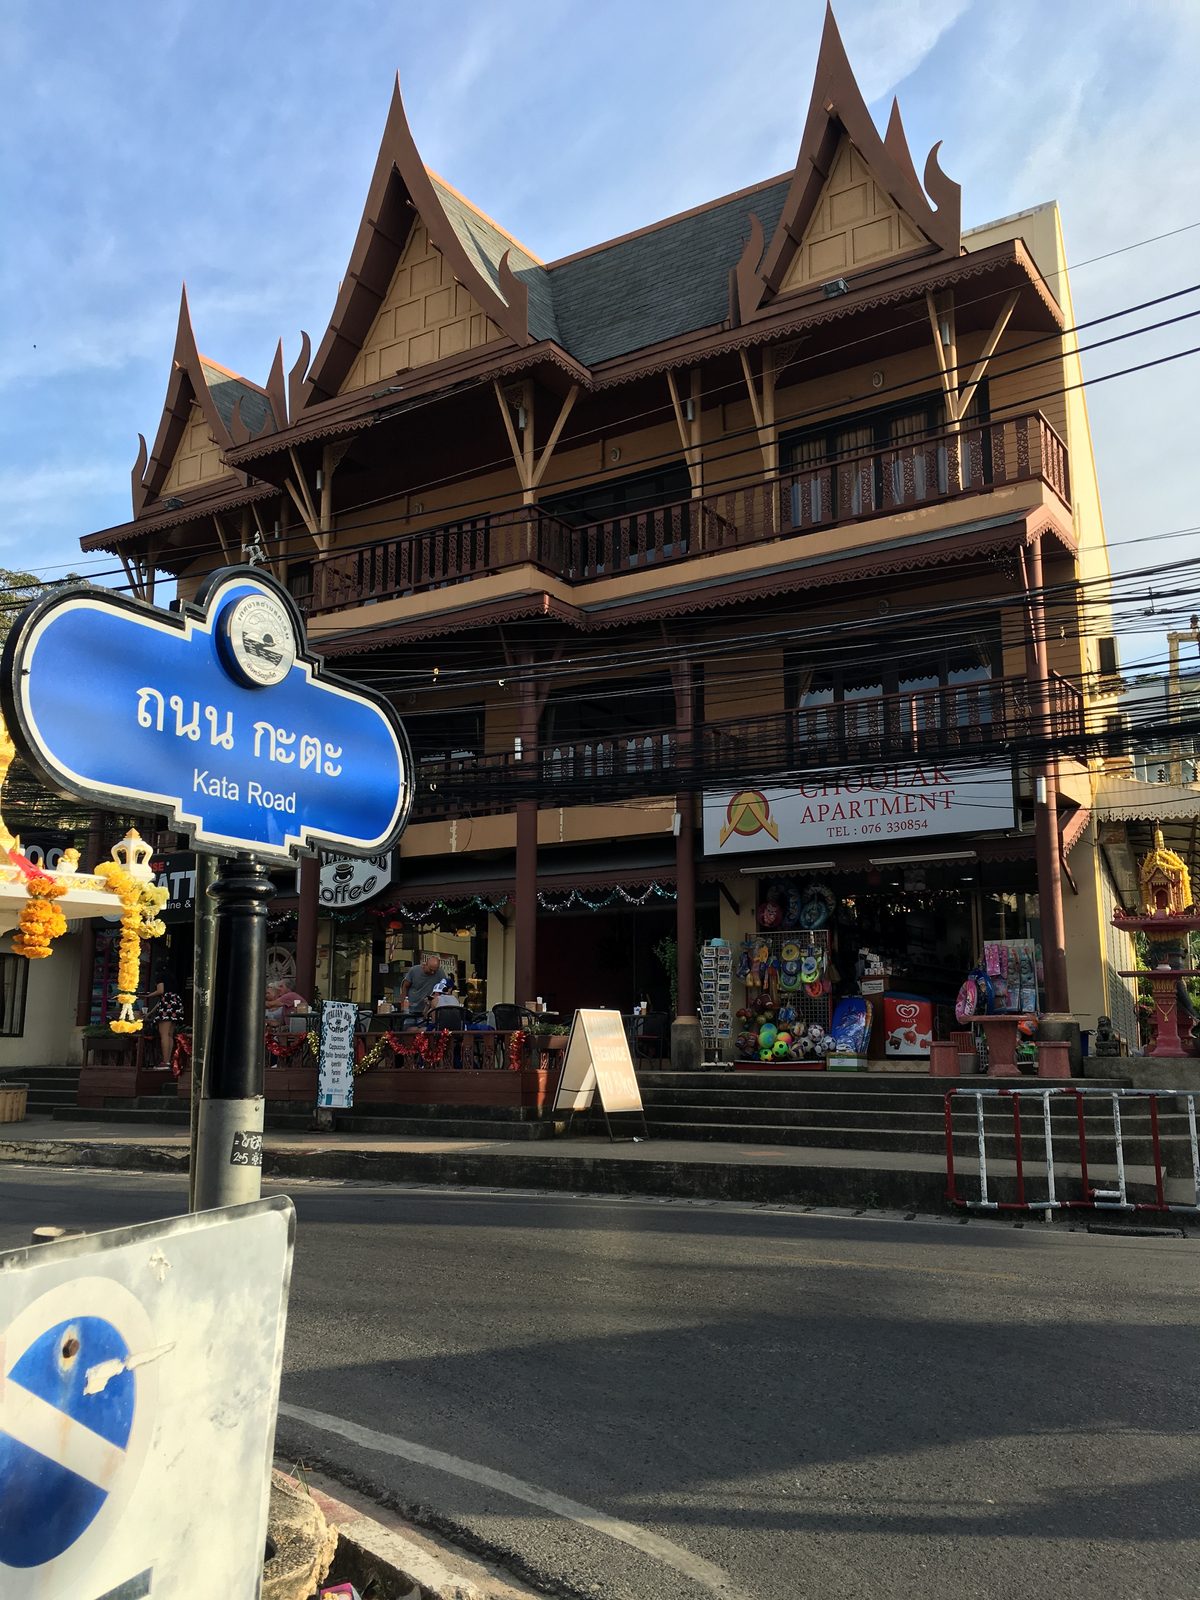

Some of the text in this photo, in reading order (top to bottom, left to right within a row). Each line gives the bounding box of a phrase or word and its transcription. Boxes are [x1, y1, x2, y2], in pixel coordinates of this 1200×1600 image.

[136, 687, 342, 776] ถนน กะตะ
[193, 768, 296, 814] Kata Road
[800, 790, 955, 825] APARTMENT
[827, 826, 850, 838] TEL
[861, 823, 882, 834] 076
[887, 819, 929, 833] 330854
[320, 875, 378, 904] offee
